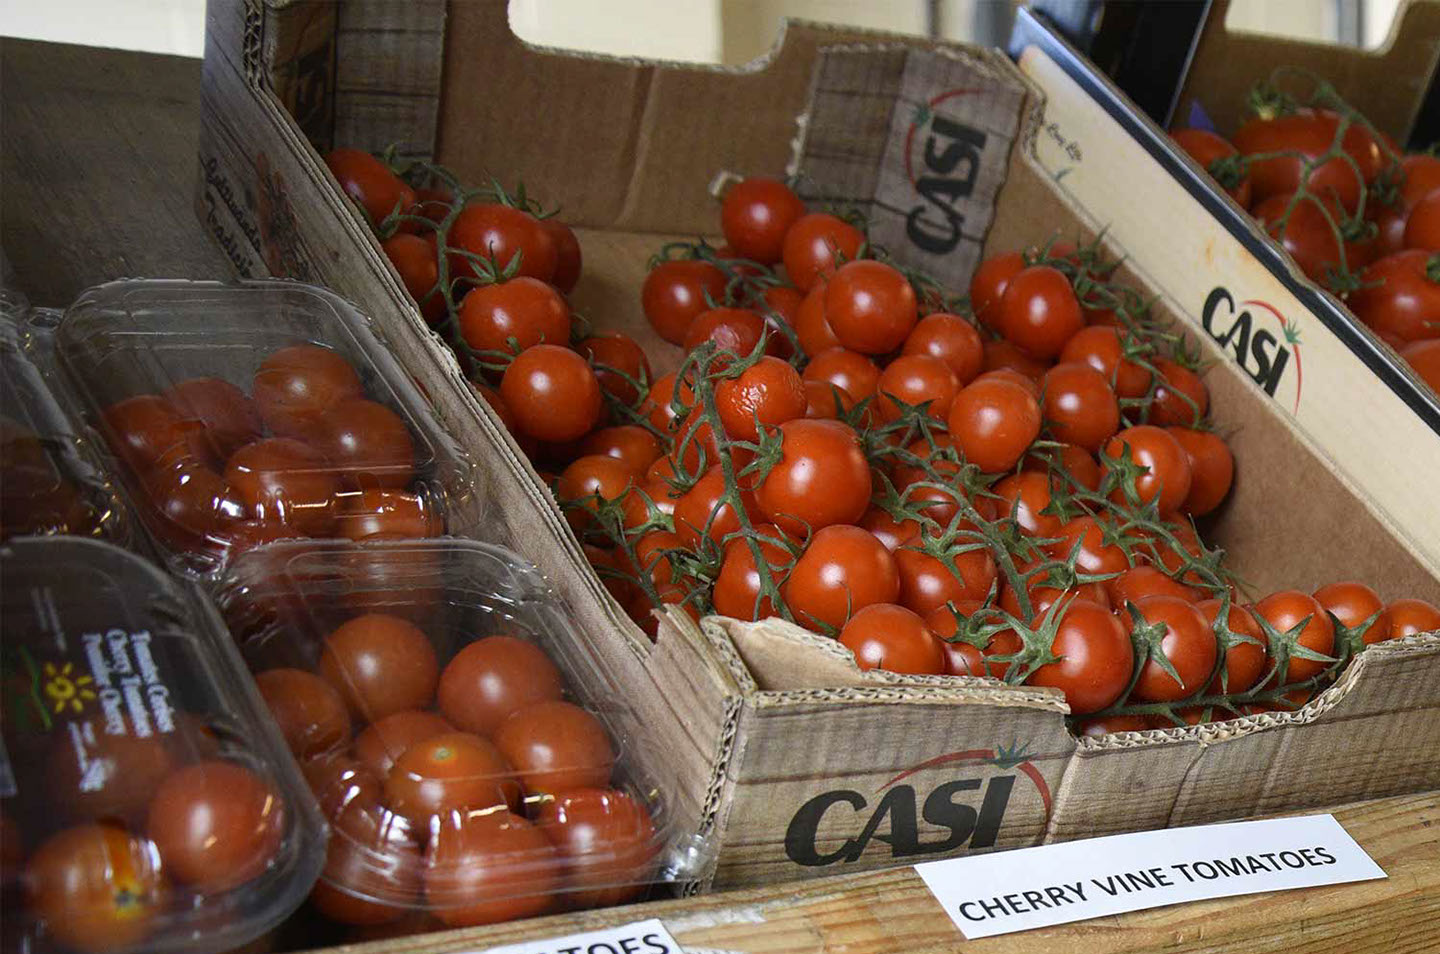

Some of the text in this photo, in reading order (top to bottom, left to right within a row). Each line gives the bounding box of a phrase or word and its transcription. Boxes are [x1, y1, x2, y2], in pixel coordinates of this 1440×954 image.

[906, 115, 987, 256] CASI
[1202, 286, 1291, 399] CASI
[784, 774, 1016, 867] CASI
[958, 846, 1337, 922] CHERRY VINE TOMATOES
